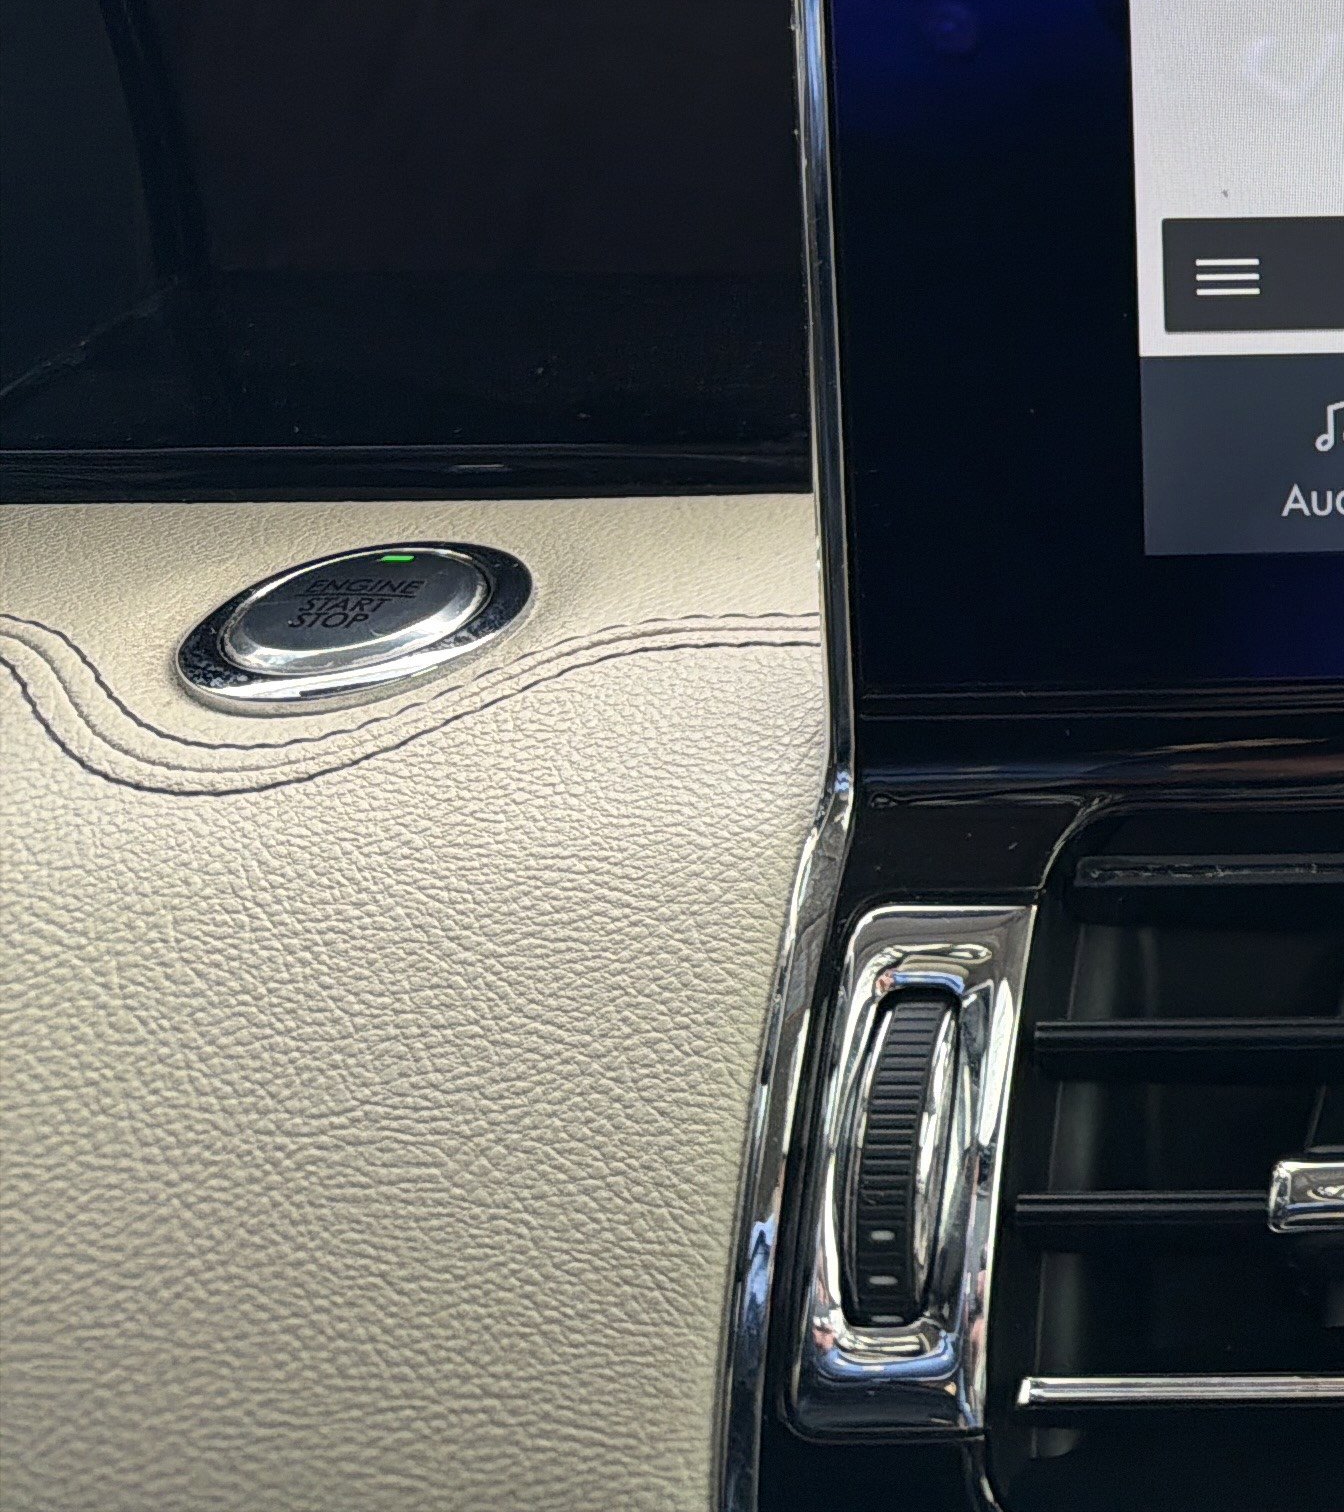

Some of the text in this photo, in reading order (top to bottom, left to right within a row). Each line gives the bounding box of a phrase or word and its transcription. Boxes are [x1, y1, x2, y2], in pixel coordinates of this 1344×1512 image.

[306, 579, 424, 594] ENGINE
[298, 597, 391, 612] START
[288, 612, 369, 628] STOP
